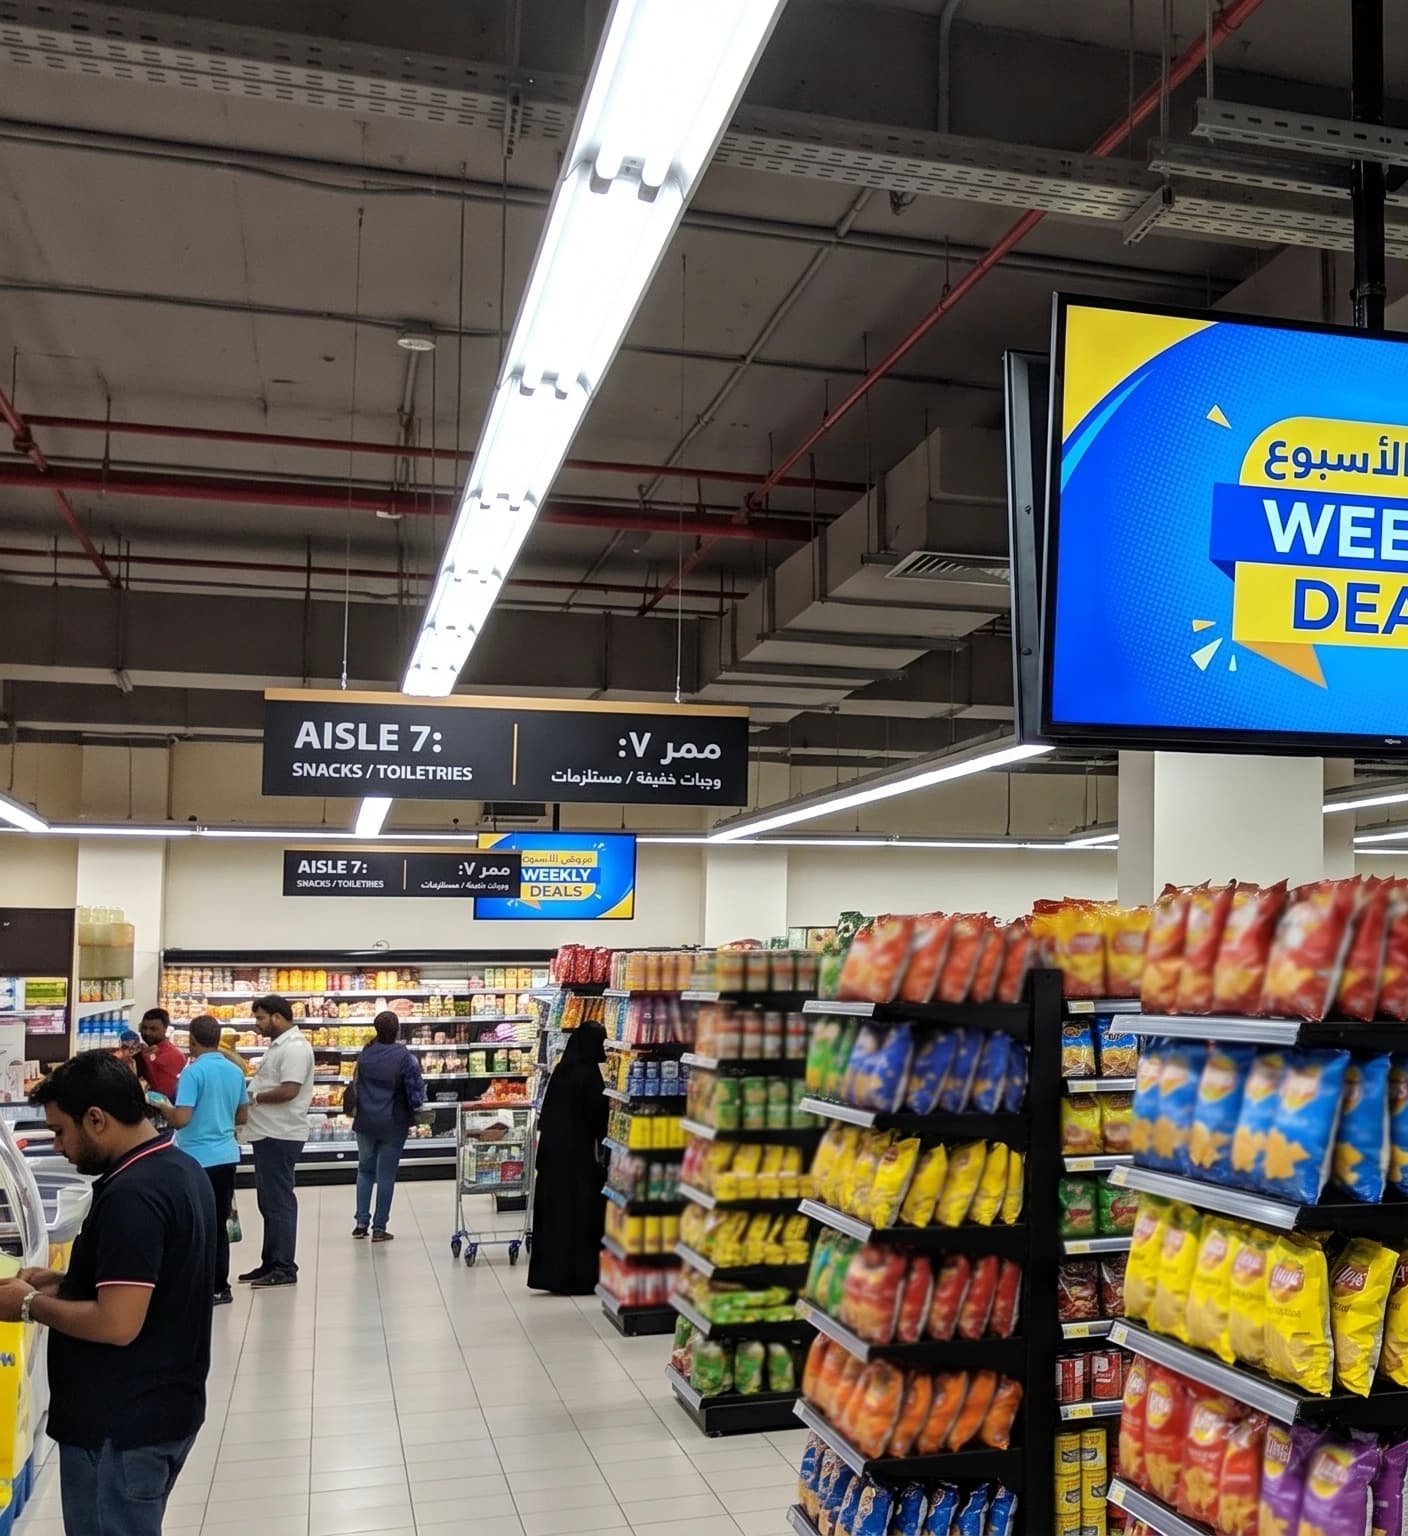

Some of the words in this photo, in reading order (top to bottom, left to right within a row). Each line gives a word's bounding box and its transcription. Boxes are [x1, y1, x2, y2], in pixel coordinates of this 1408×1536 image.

[294, 721, 399, 751] AISLE
[409, 725, 442, 753] 7:
[659, 741, 722, 765] ممر
[292, 762, 363, 778] SNACKS
[376, 764, 473, 781] TOILETRIES
[551, 768, 623, 786] مستلزمات
[635, 771, 676, 788] خفيفة
[680, 772, 722, 790] وجبات
[297, 860, 348, 874] AISLE
[350, 860, 368, 874] 7:
[478, 866, 511, 878] ممر
[521, 868, 592, 881] WEEKLY
[530, 885, 582, 897] DEALS
